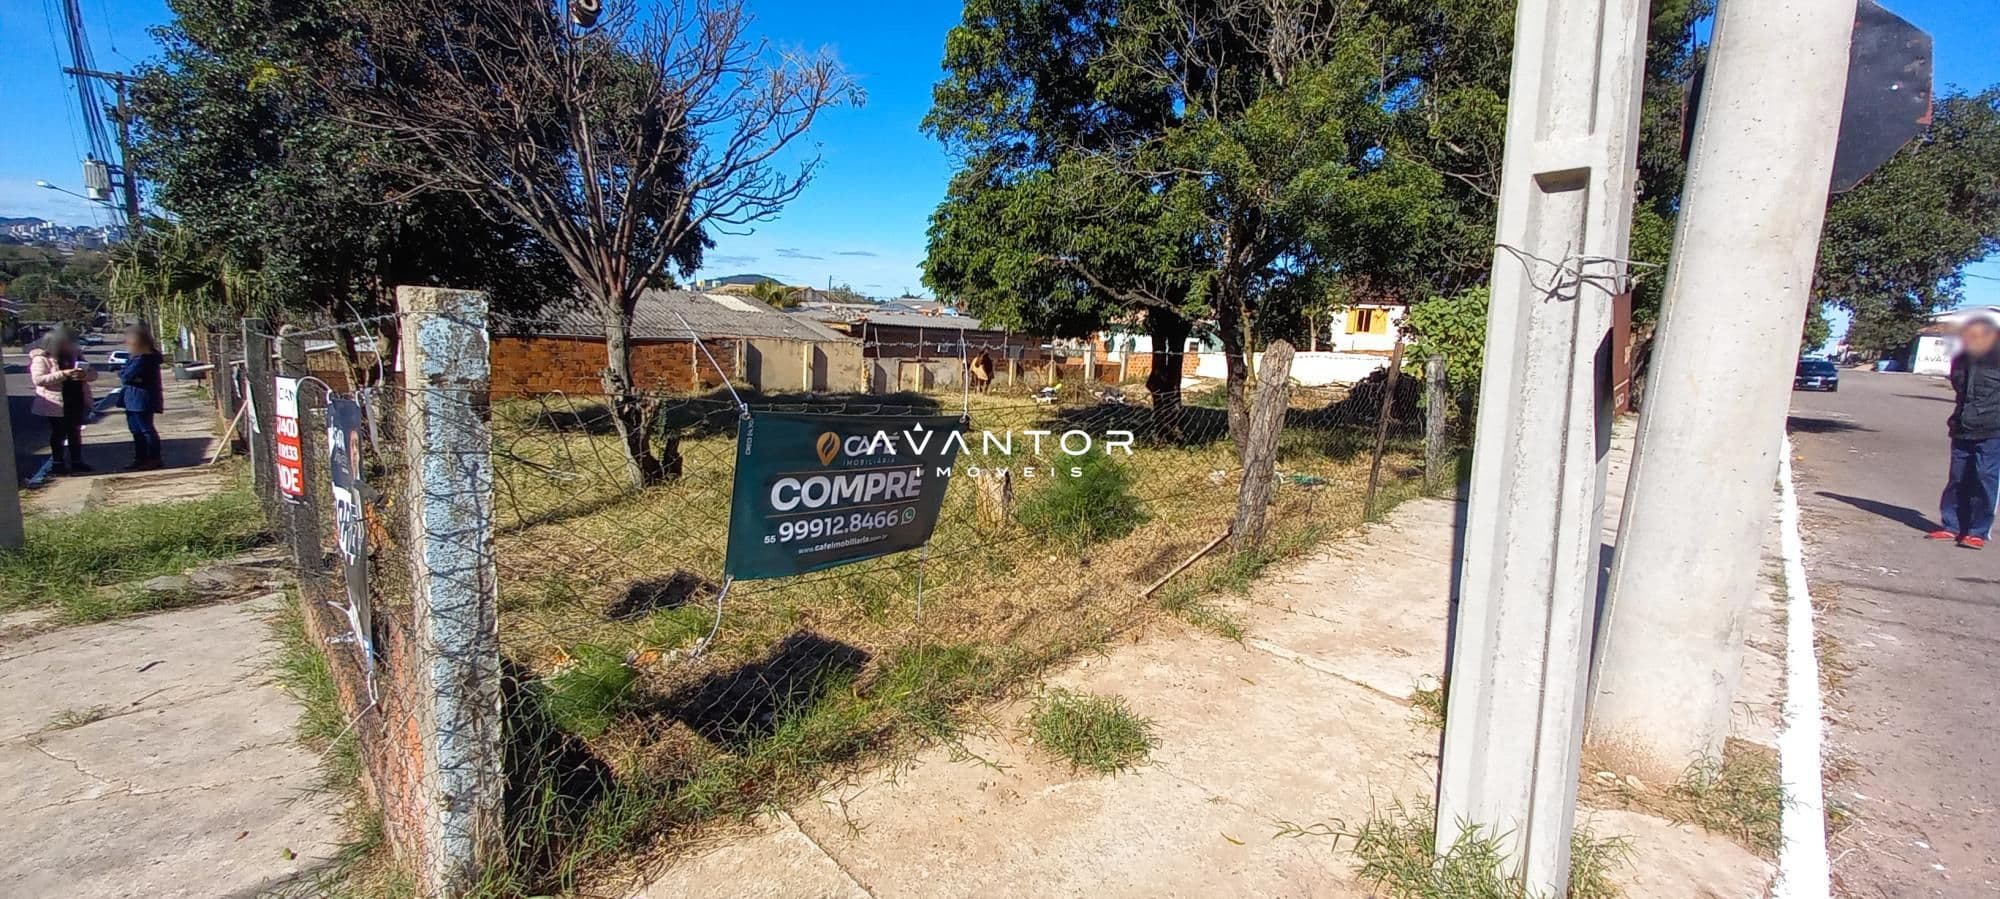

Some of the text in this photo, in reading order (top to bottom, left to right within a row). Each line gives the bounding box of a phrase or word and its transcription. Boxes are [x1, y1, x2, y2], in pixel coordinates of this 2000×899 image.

[843, 432, 900, 457] CAFÉ
[770, 468, 925, 511] COMPRE
[763, 509, 899, 544] 55 99912.8466
